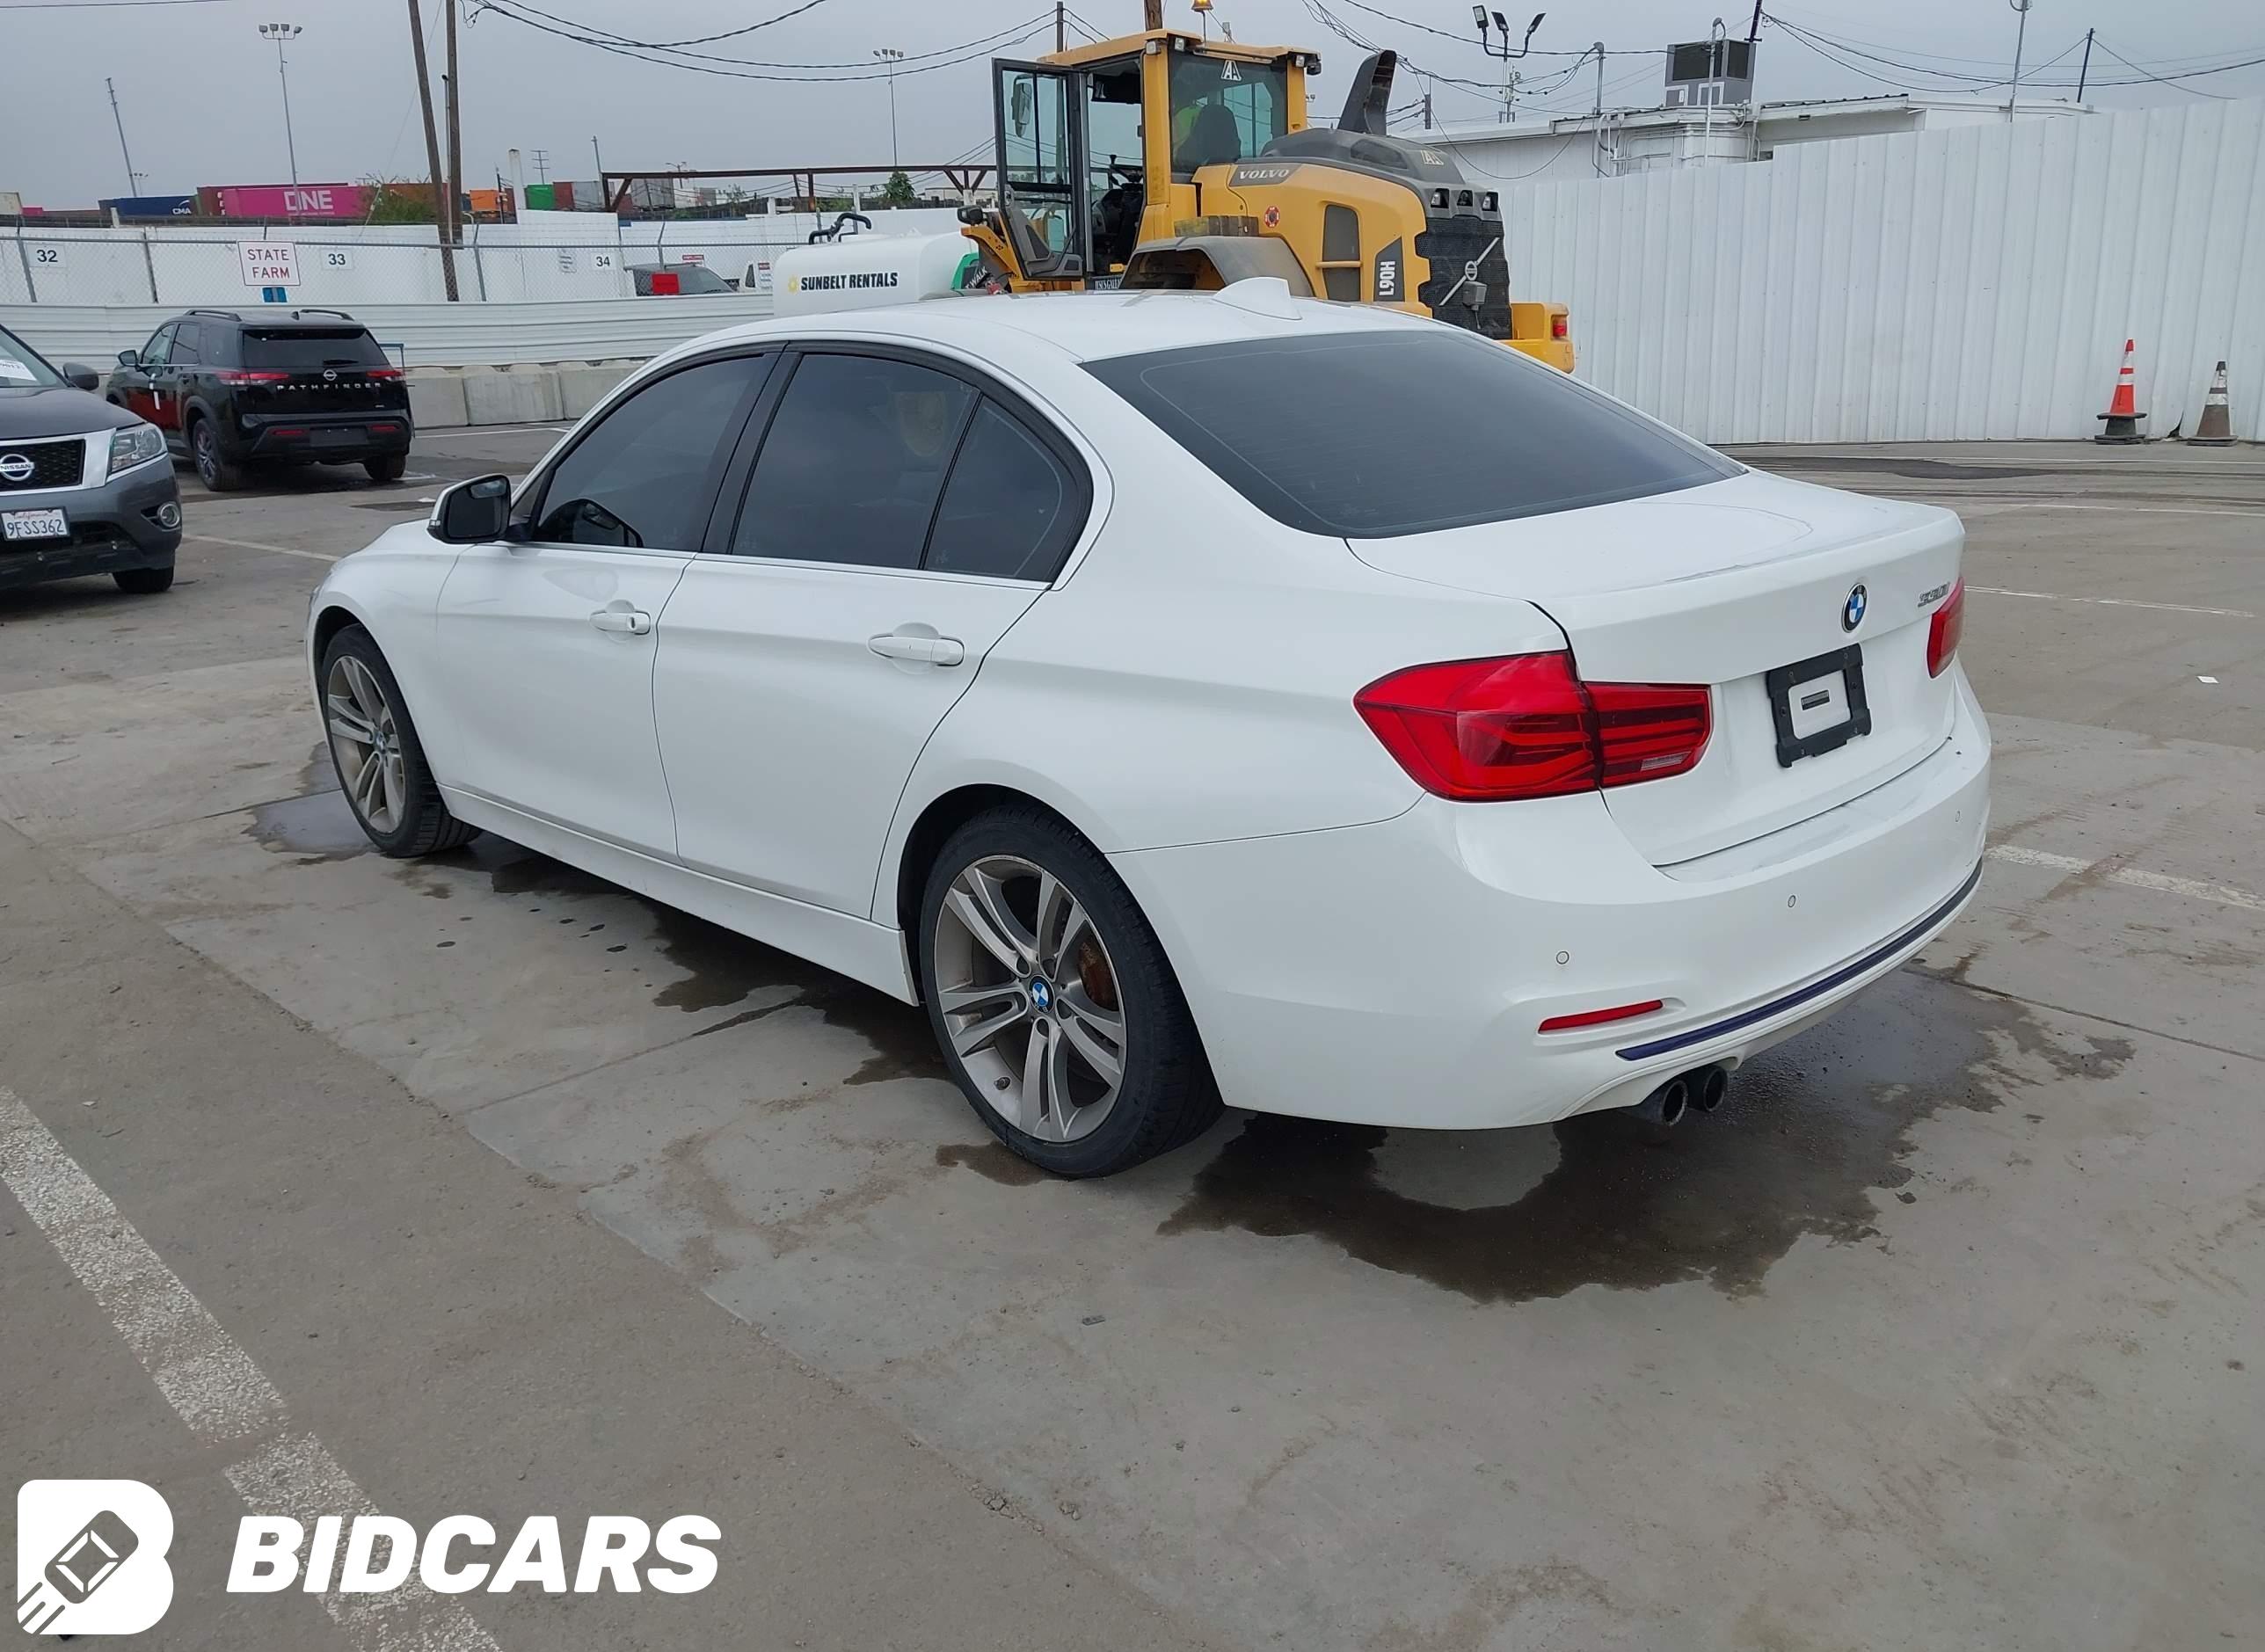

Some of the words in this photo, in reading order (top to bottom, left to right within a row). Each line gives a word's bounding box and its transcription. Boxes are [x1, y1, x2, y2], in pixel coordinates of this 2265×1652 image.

[1240, 170, 1290, 179] VOLVO
[36, 249, 58, 263] 32
[247, 249, 289, 261] STATE
[328, 253, 346, 266] 33
[596, 256, 610, 267] 34
[252, 267, 290, 279] FARM
[1379, 260, 1396, 296] L90H
[801, 275, 847, 291] SUNBELT
[849, 272, 899, 288] RENTALS
[7, 519, 64, 536] 9FSS362
